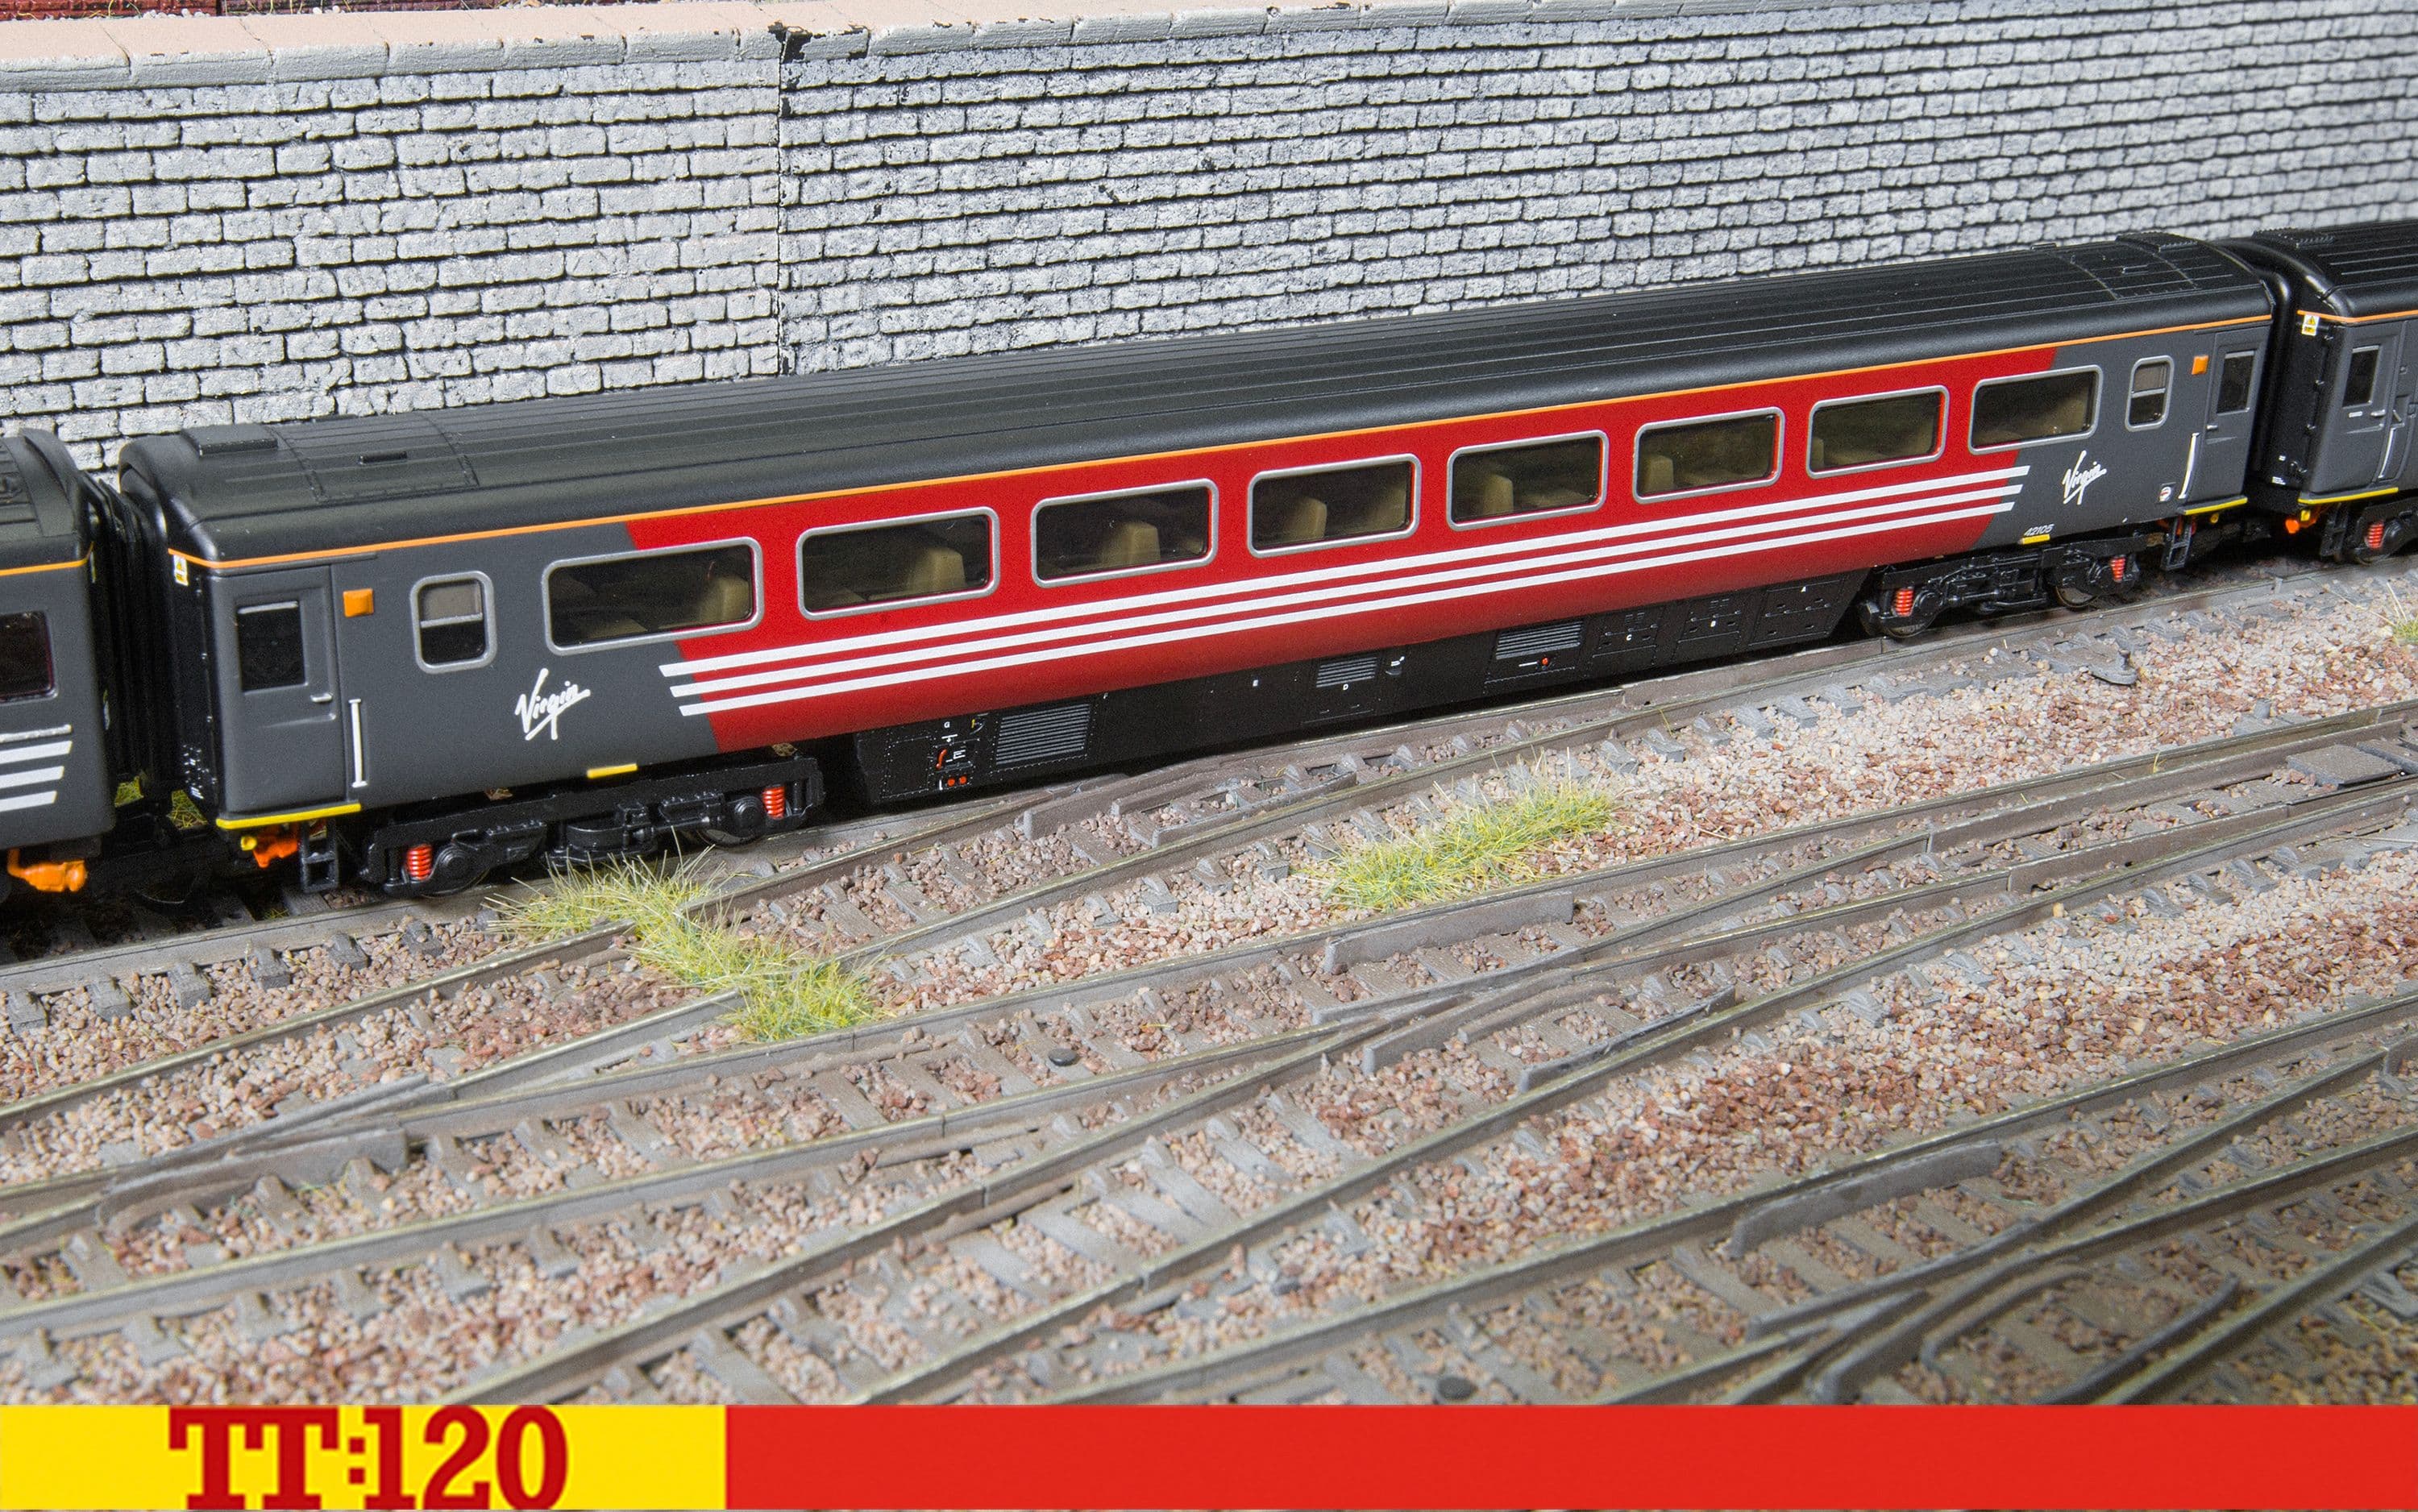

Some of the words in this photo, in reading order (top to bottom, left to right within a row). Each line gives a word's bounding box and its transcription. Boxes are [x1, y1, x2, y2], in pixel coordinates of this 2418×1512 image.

[2062, 450, 2107, 505] Virgin
[2024, 523, 2055, 537] 42105
[514, 667, 591, 741] Virgin
